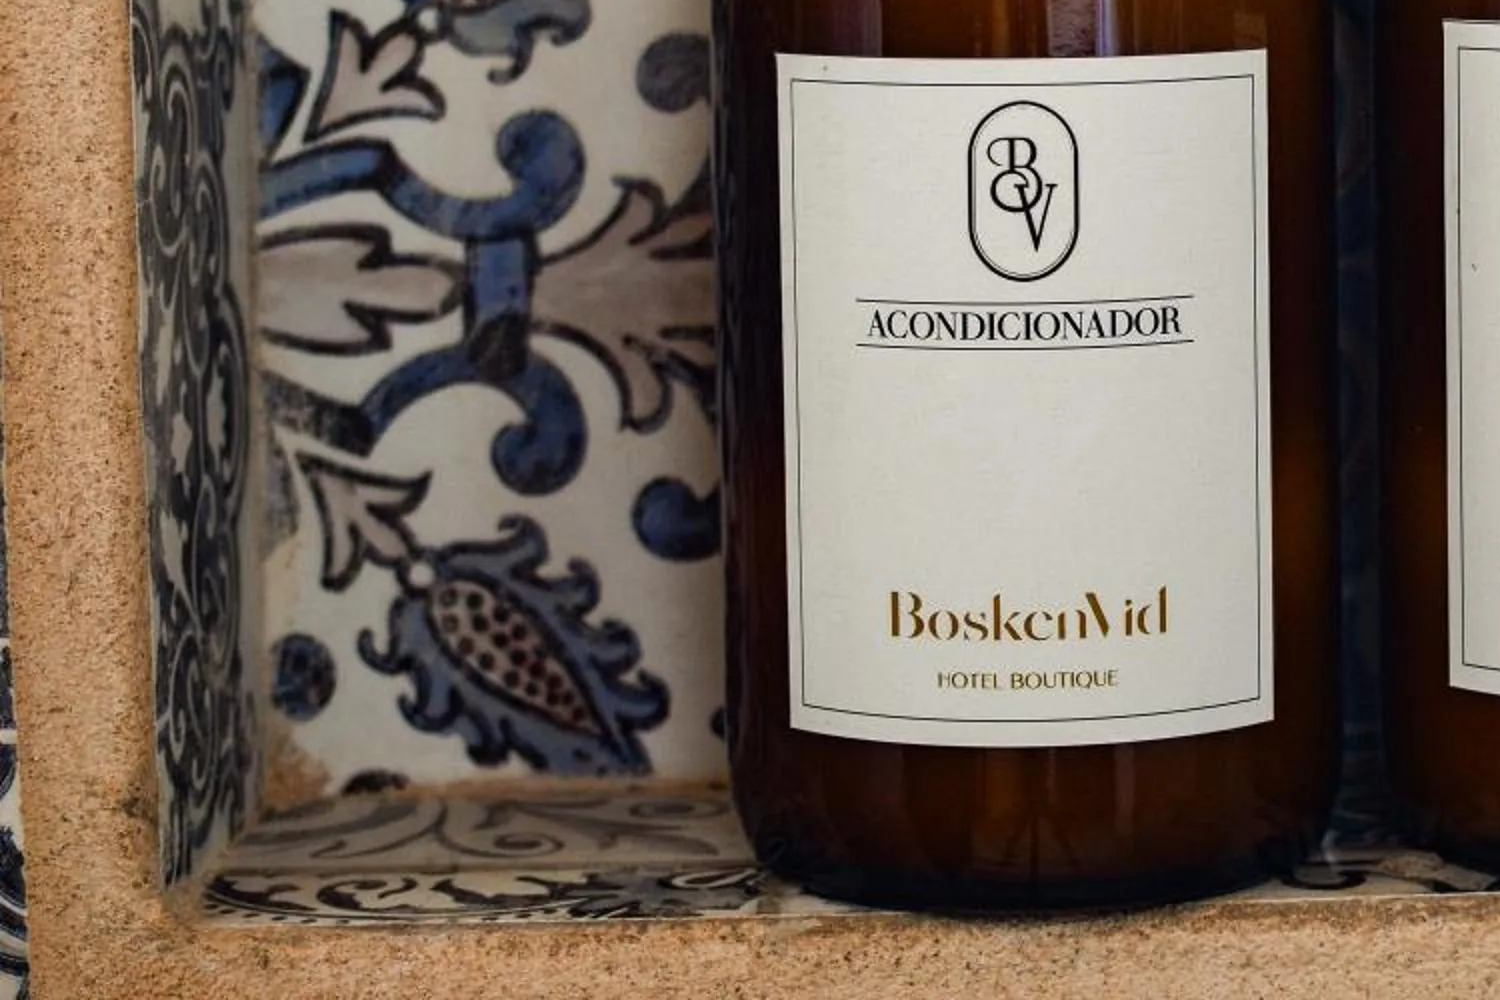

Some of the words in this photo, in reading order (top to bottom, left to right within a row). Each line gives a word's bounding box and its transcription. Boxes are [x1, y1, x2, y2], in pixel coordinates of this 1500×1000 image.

[867, 305, 1182, 342] ACONDICIONADOR
[888, 585, 1168, 643] BoskenVid
[937, 670, 1000, 690] HOTEL
[1010, 669, 1119, 690] BOUTIQUE
